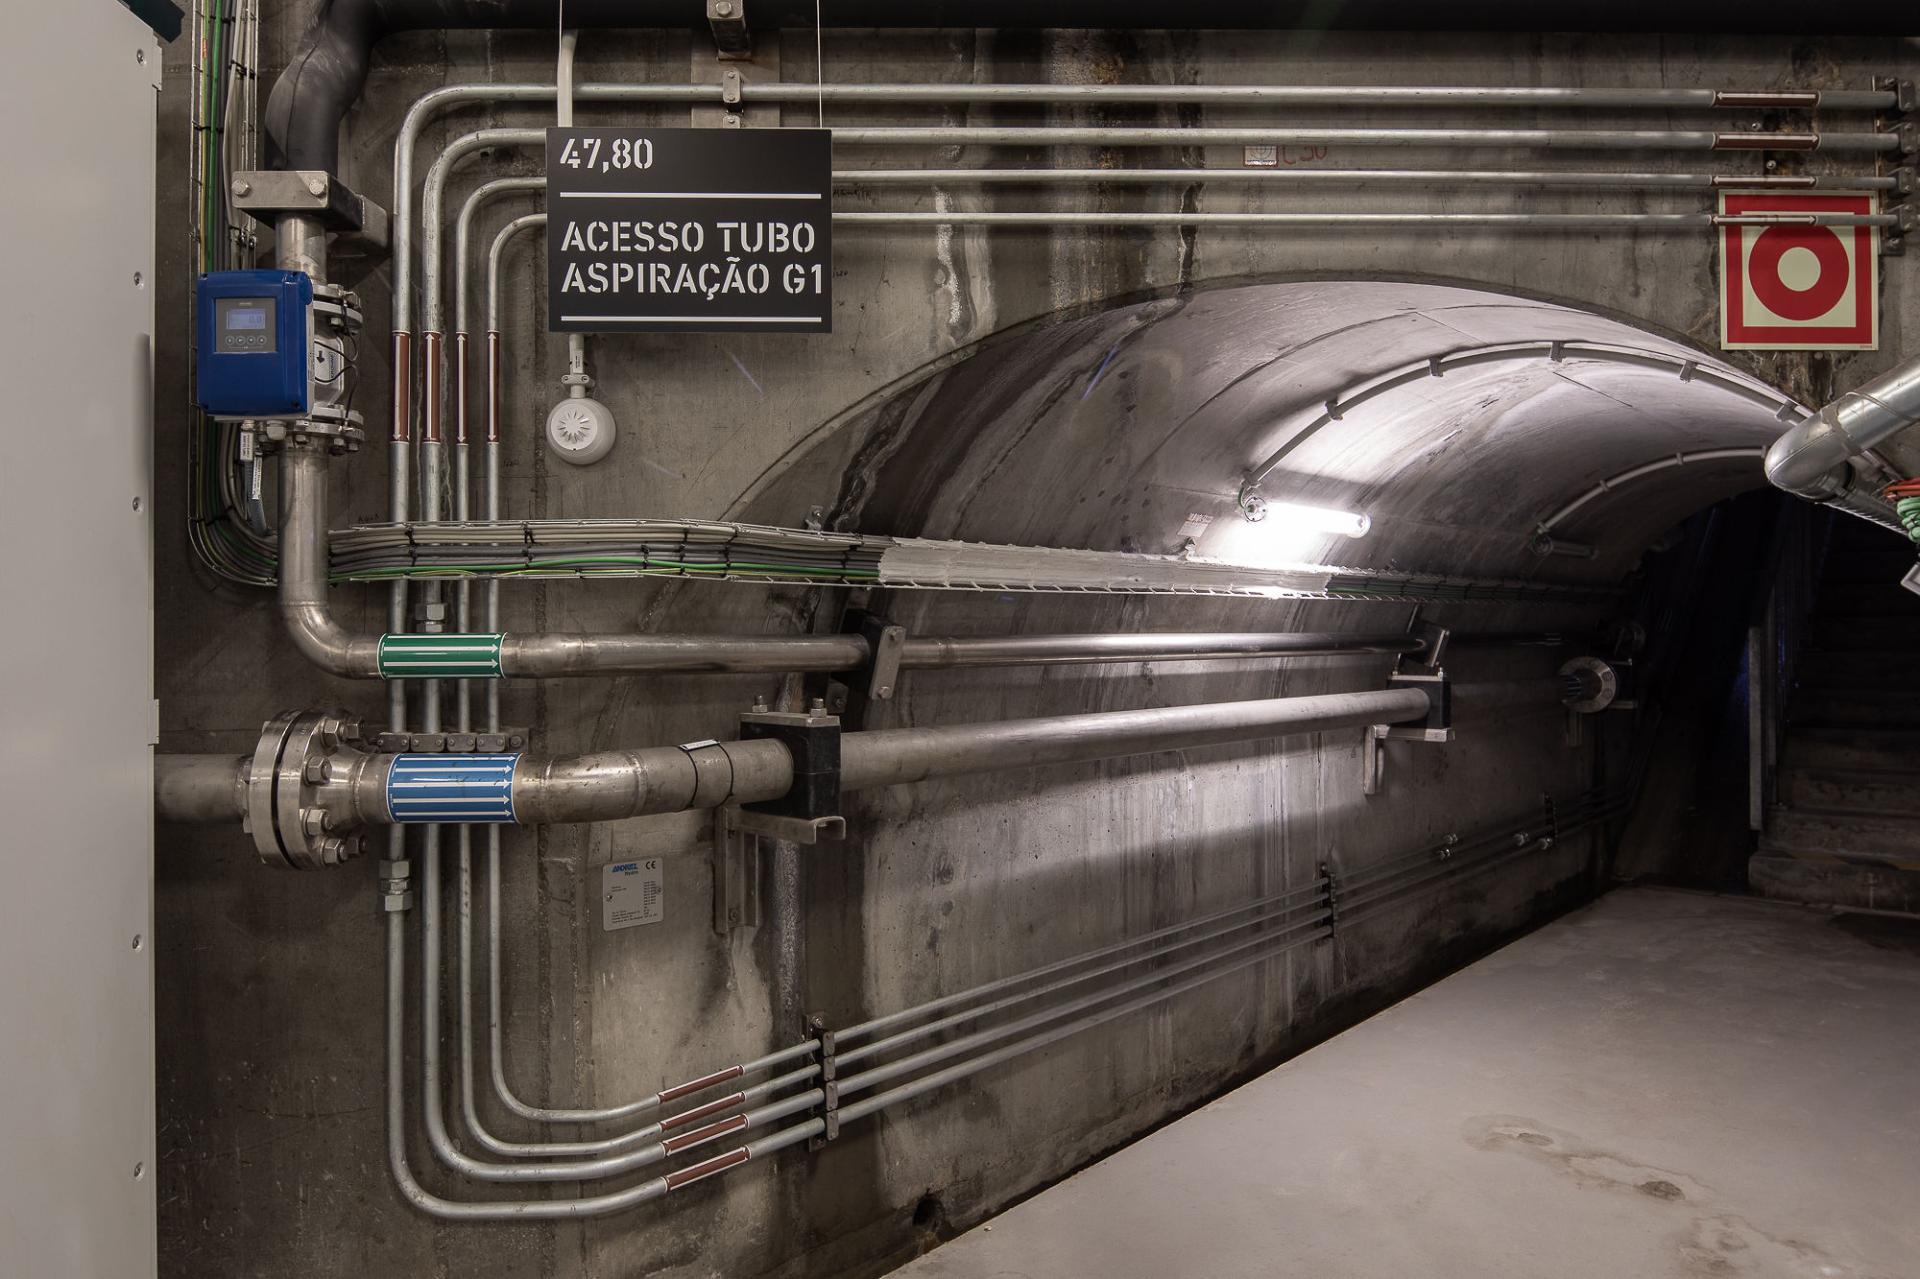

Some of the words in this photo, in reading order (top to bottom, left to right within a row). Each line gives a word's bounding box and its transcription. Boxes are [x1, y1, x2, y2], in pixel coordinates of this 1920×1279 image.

[560, 138, 653, 173] 47,80
[560, 221, 704, 252] ACESSO
[716, 222, 815, 253] TUBO
[561, 256, 770, 300] ASPIRAÇÃO
[782, 263, 822, 294] G1
